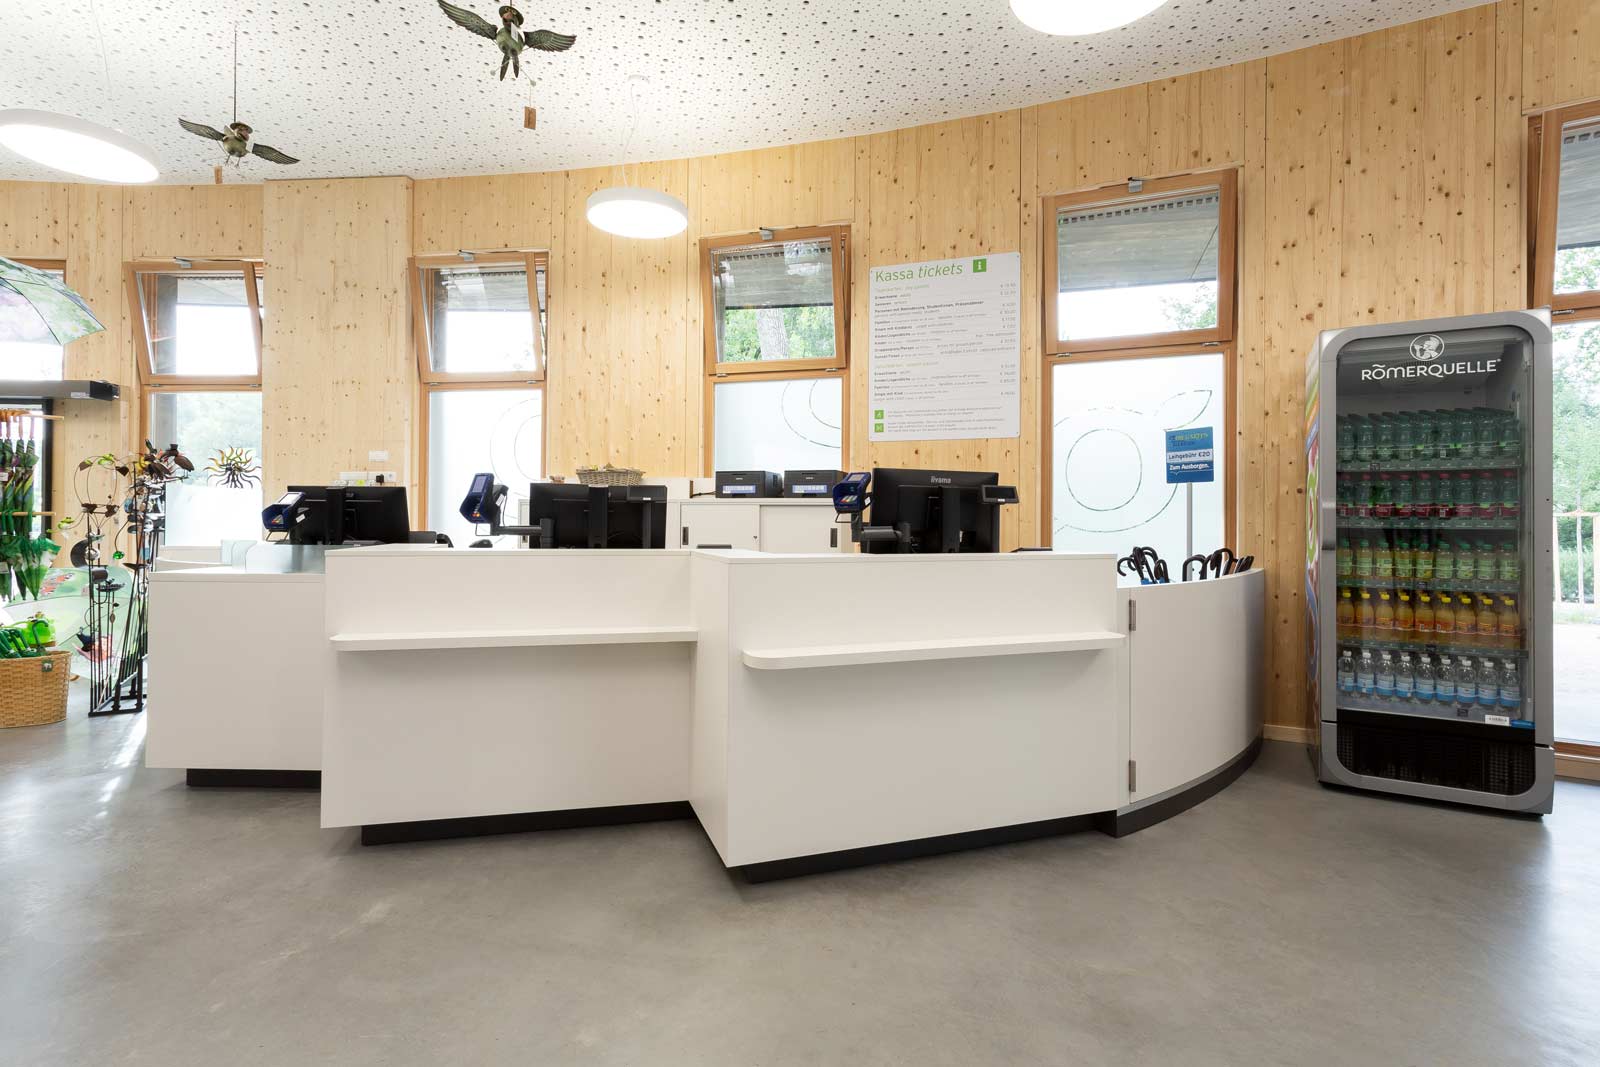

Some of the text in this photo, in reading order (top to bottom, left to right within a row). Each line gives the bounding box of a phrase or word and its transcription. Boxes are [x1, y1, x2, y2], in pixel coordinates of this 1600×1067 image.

[875, 269, 914, 283] Kassa
[918, 263, 963, 279] tickets
[1168, 452, 1197, 460] Leihgebühr
